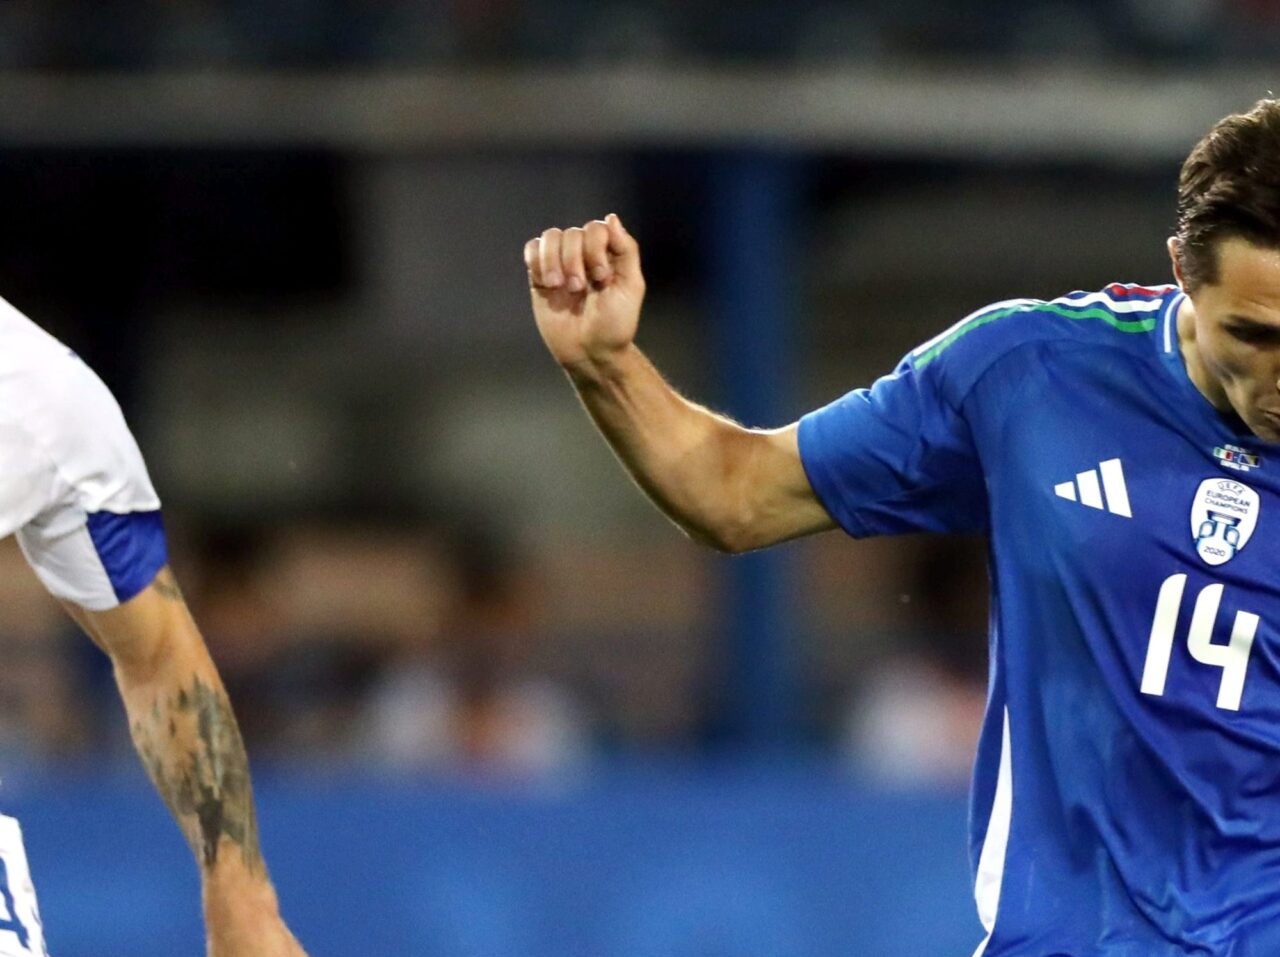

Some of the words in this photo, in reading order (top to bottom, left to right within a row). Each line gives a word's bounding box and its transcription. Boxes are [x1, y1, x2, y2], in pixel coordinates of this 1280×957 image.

[1206, 490, 1251, 507] EUROPEAN
[1203, 545, 1226, 557] 2020
[1140, 573, 1260, 712] 14
